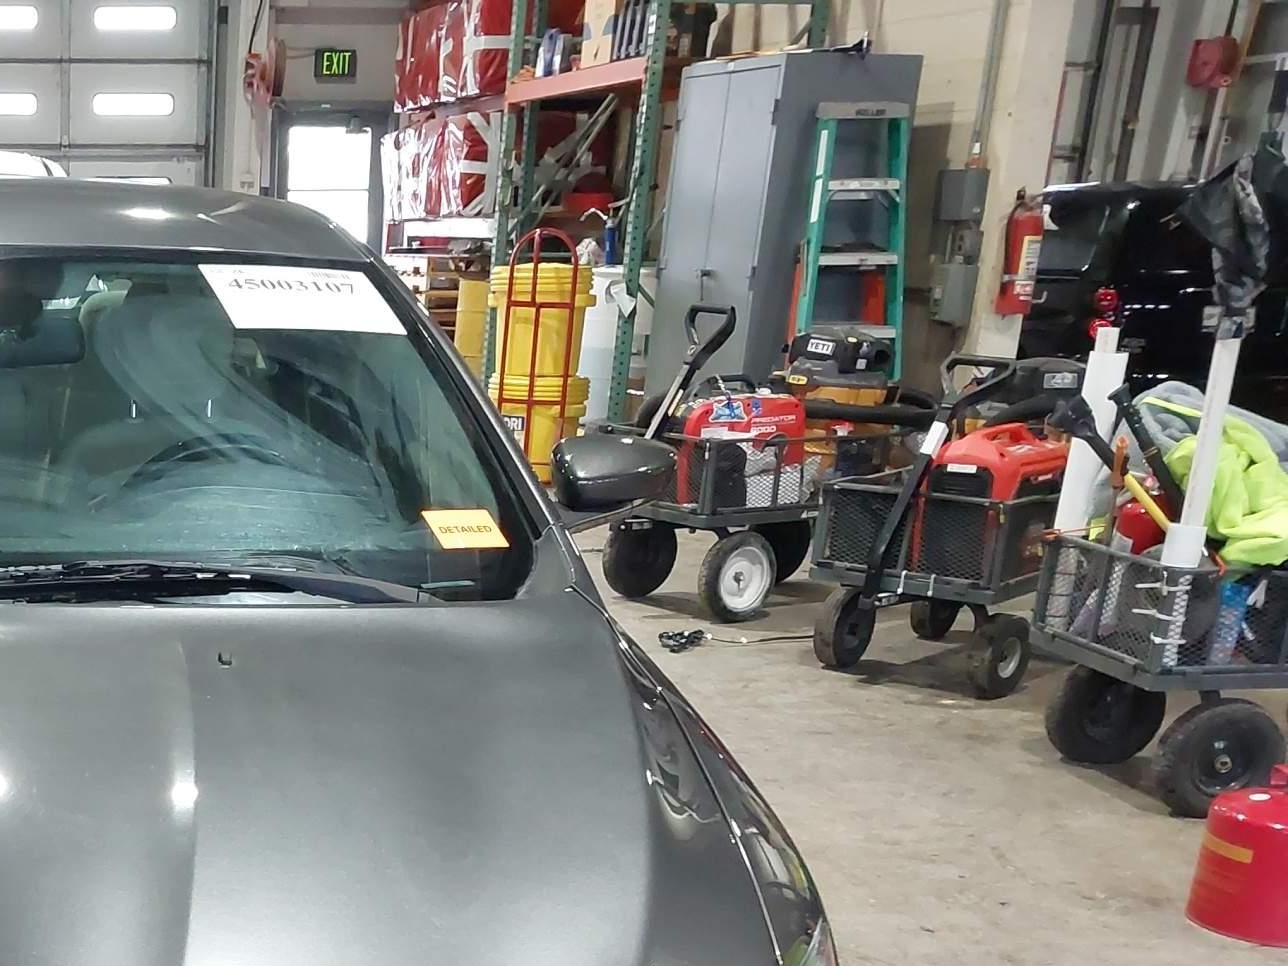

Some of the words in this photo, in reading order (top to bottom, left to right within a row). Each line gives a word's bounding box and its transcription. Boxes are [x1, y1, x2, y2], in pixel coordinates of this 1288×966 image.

[323, 52, 352, 75] EXIT
[228, 278, 354, 295] 45003107
[810, 341, 831, 352] YETI
[751, 415, 796, 423] PREDATOR
[438, 525, 492, 533] DETAILED
